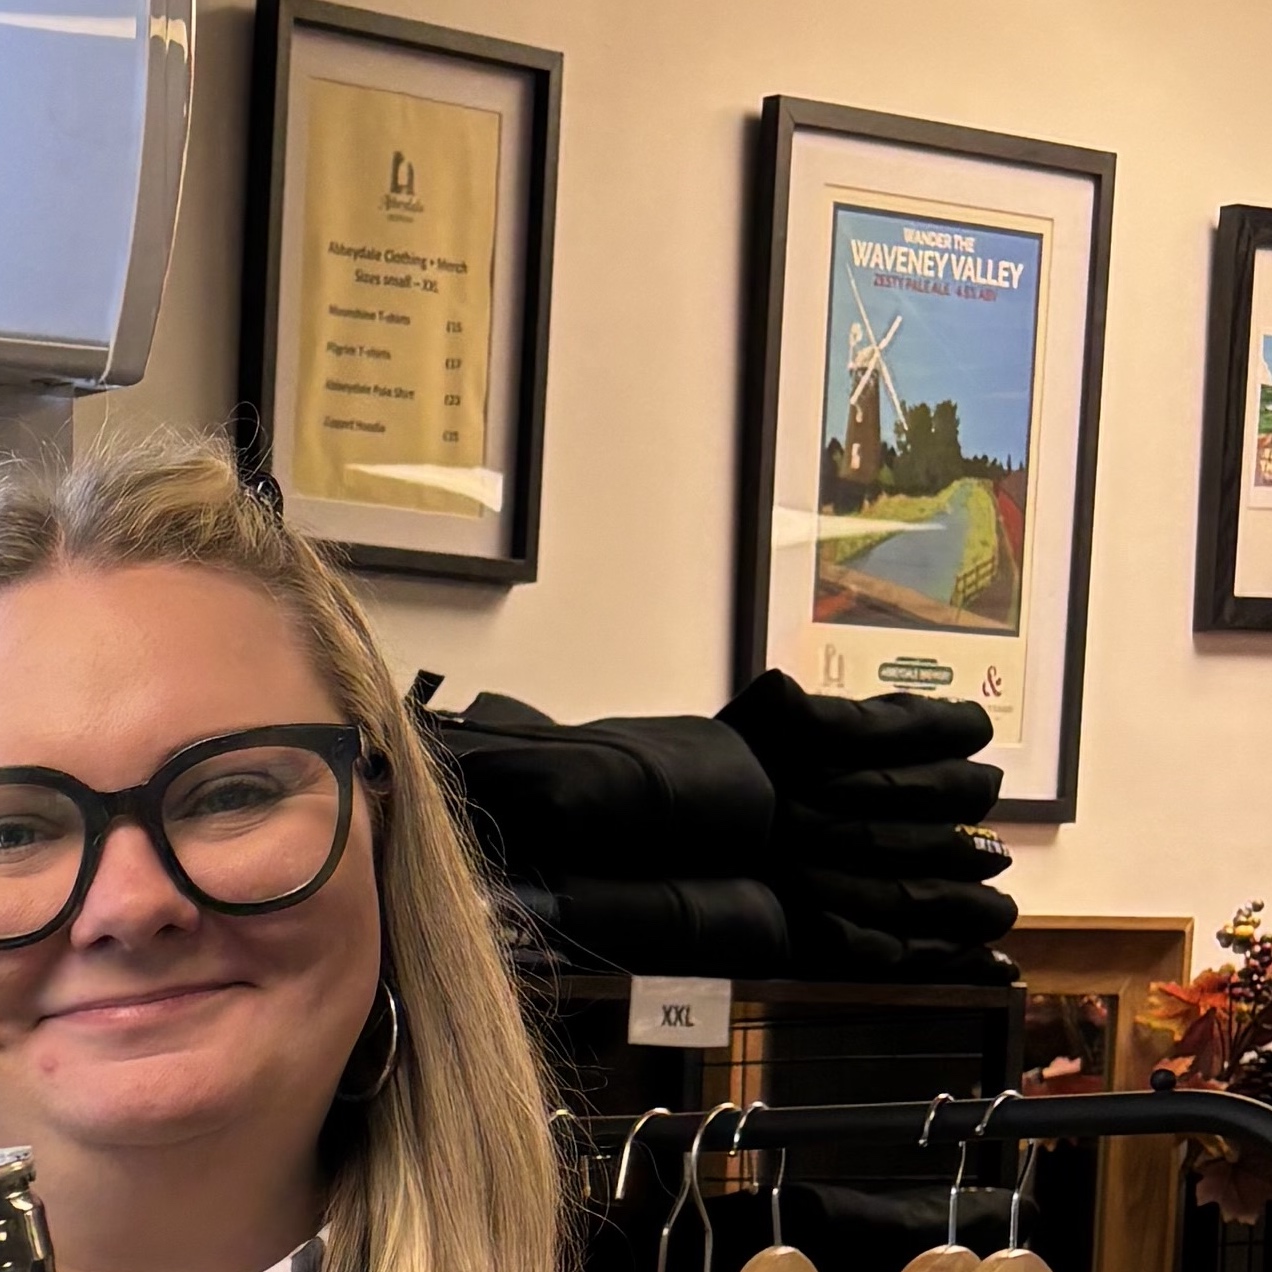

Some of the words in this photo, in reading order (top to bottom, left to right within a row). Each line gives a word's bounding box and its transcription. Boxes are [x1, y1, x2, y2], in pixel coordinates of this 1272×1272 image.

[903, 227, 951, 249] WANDER
[954, 235, 976, 253] THE
[384, 249, 427, 270] Clothing
[851, 239, 948, 279] WAVENEY
[951, 254, 1024, 289] VALLEY
[383, 274, 412, 288] small
[661, 1004, 695, 1028] XXL
